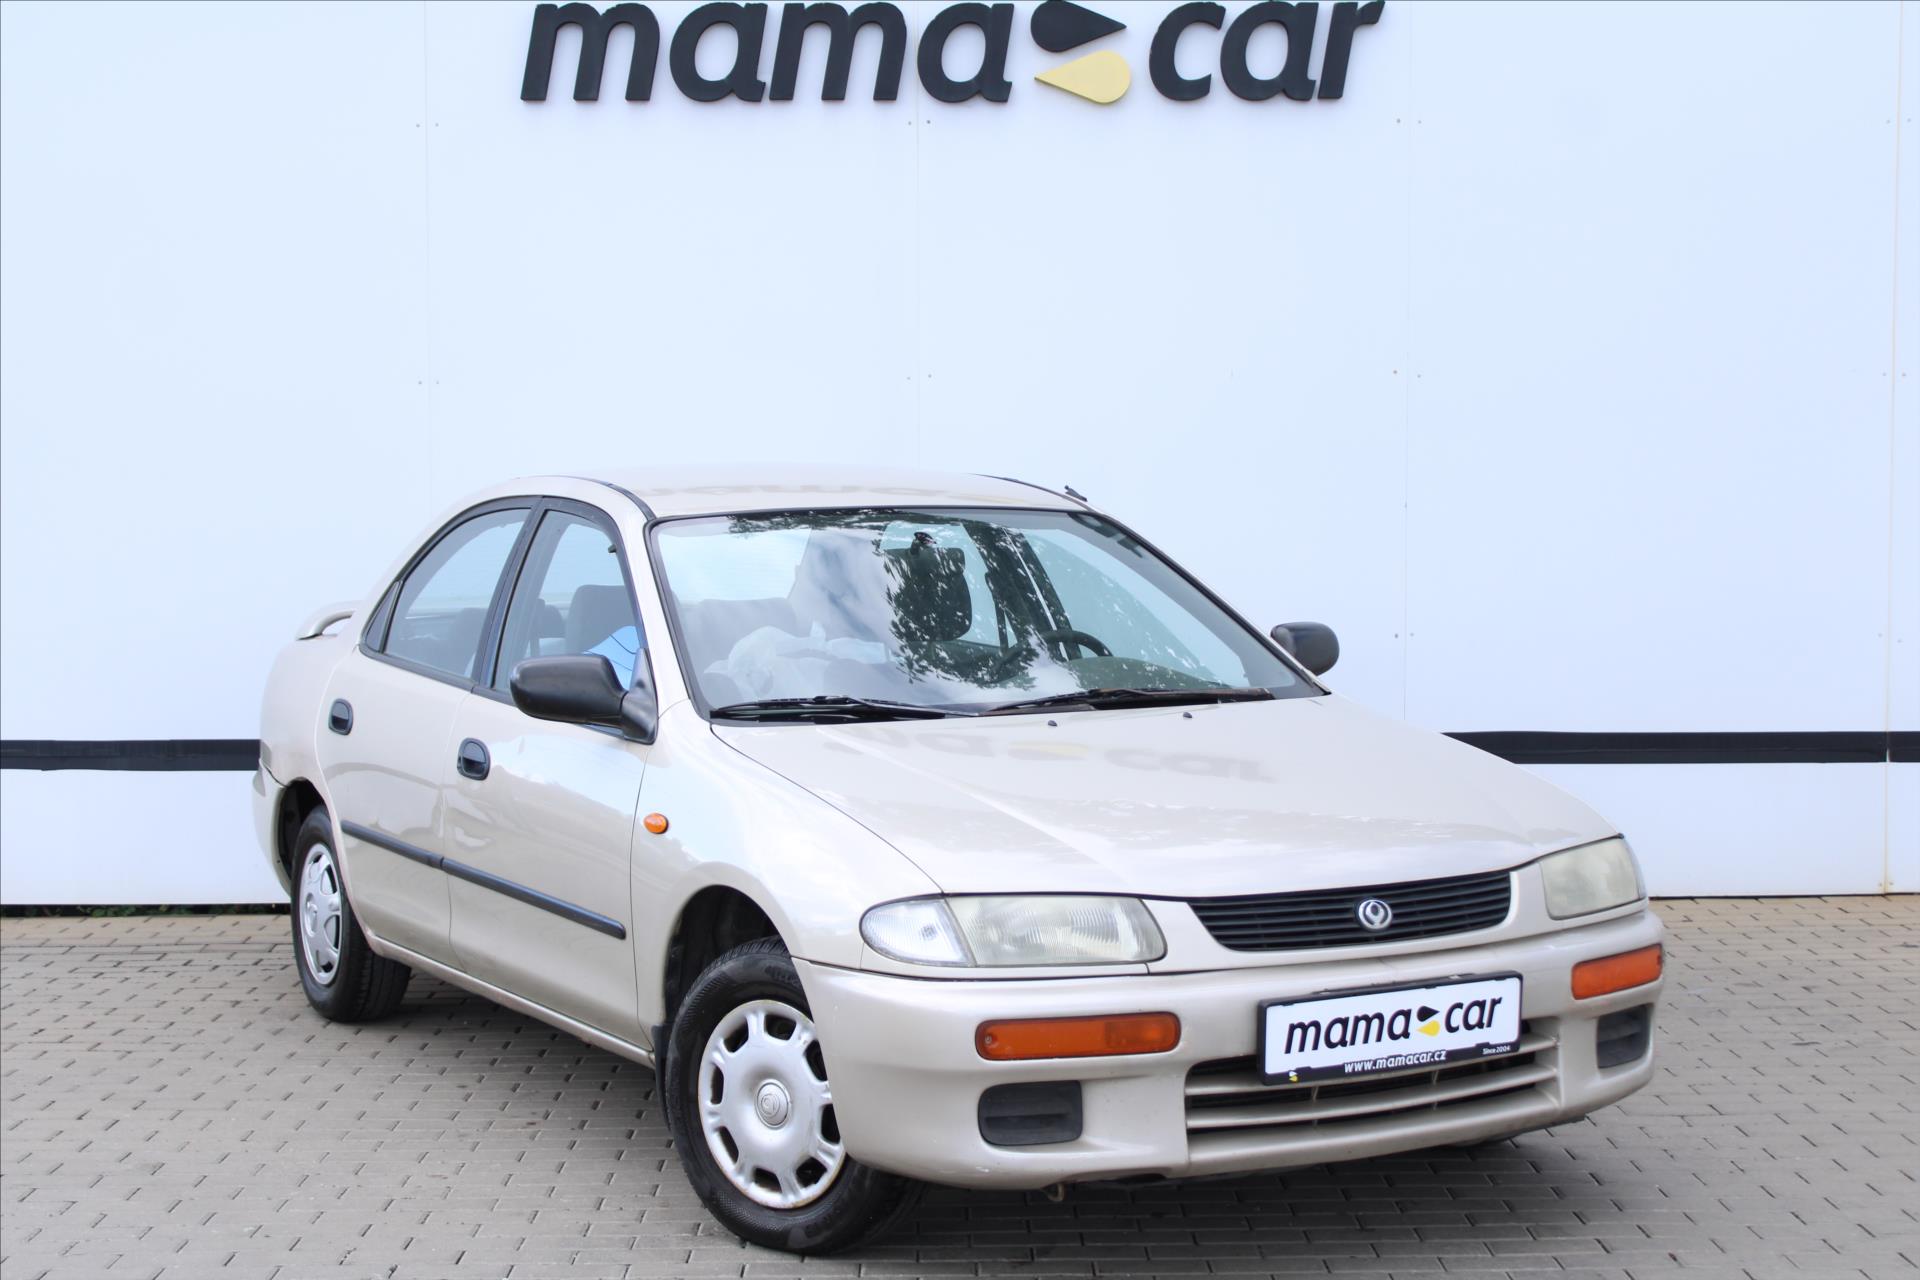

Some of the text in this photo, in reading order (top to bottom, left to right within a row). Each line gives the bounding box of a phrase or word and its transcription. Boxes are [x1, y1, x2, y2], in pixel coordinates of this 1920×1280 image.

[520, 1, 1386, 104] mama car
[1284, 996, 1503, 1054] mama car
[1344, 1050, 1447, 1073] www.mamacar.cz
